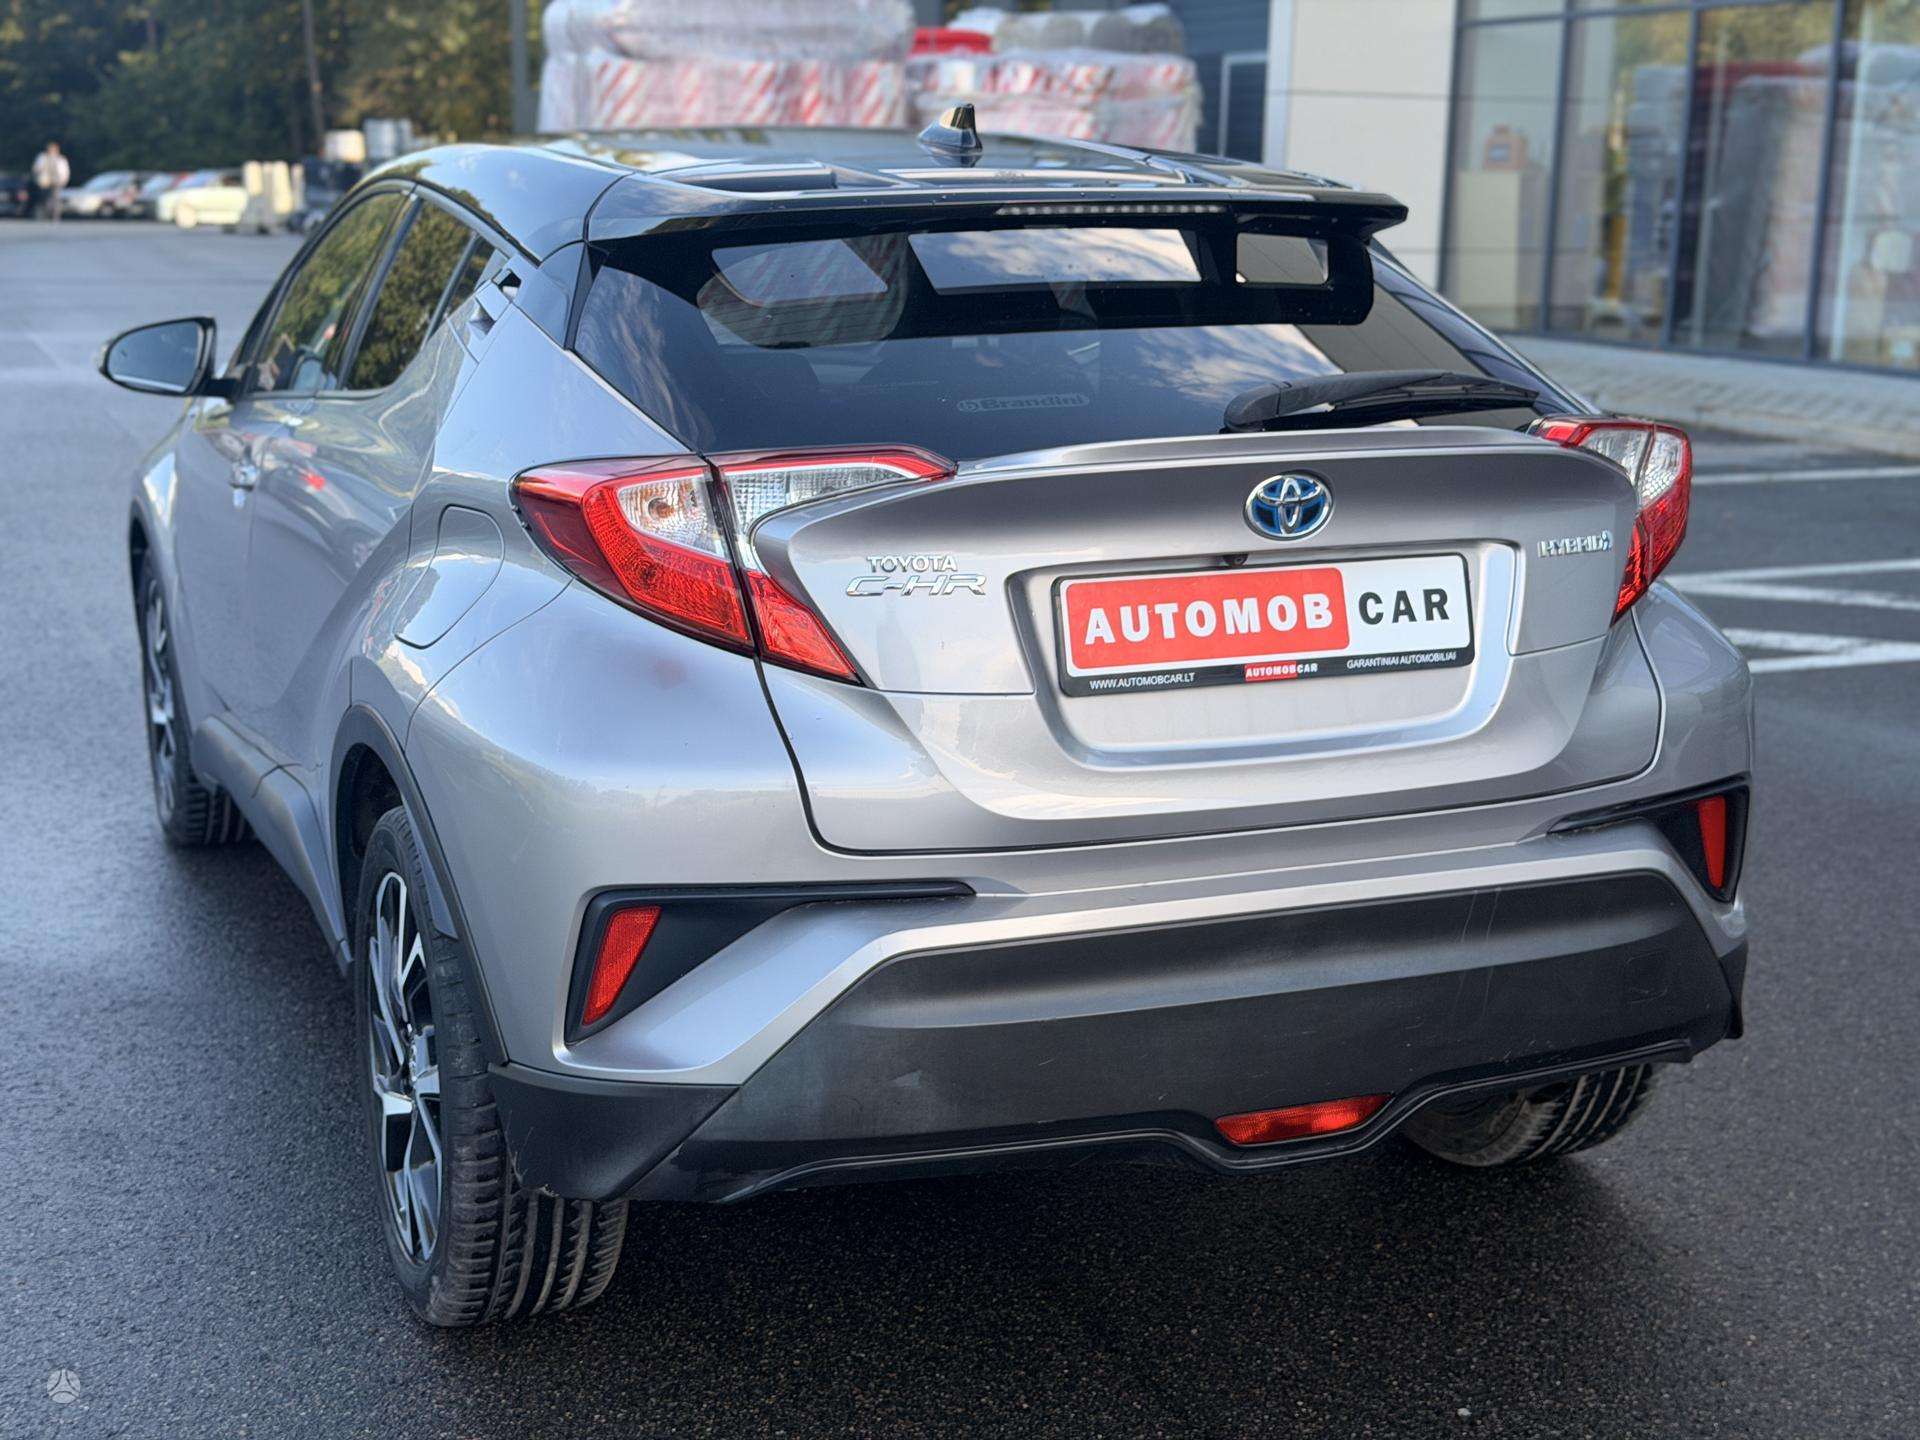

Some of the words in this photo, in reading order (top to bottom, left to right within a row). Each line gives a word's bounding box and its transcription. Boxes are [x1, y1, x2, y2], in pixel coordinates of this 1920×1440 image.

[1537, 534, 1604, 558] HYBRID
[867, 554, 958, 574] TOYOTA
[846, 573, 986, 597] C-HR
[1085, 593, 1333, 645] AUTOMOB
[1358, 588, 1450, 625] CAR
[1089, 672, 1195, 690] WWW.AUTOMOBCAR.LT
